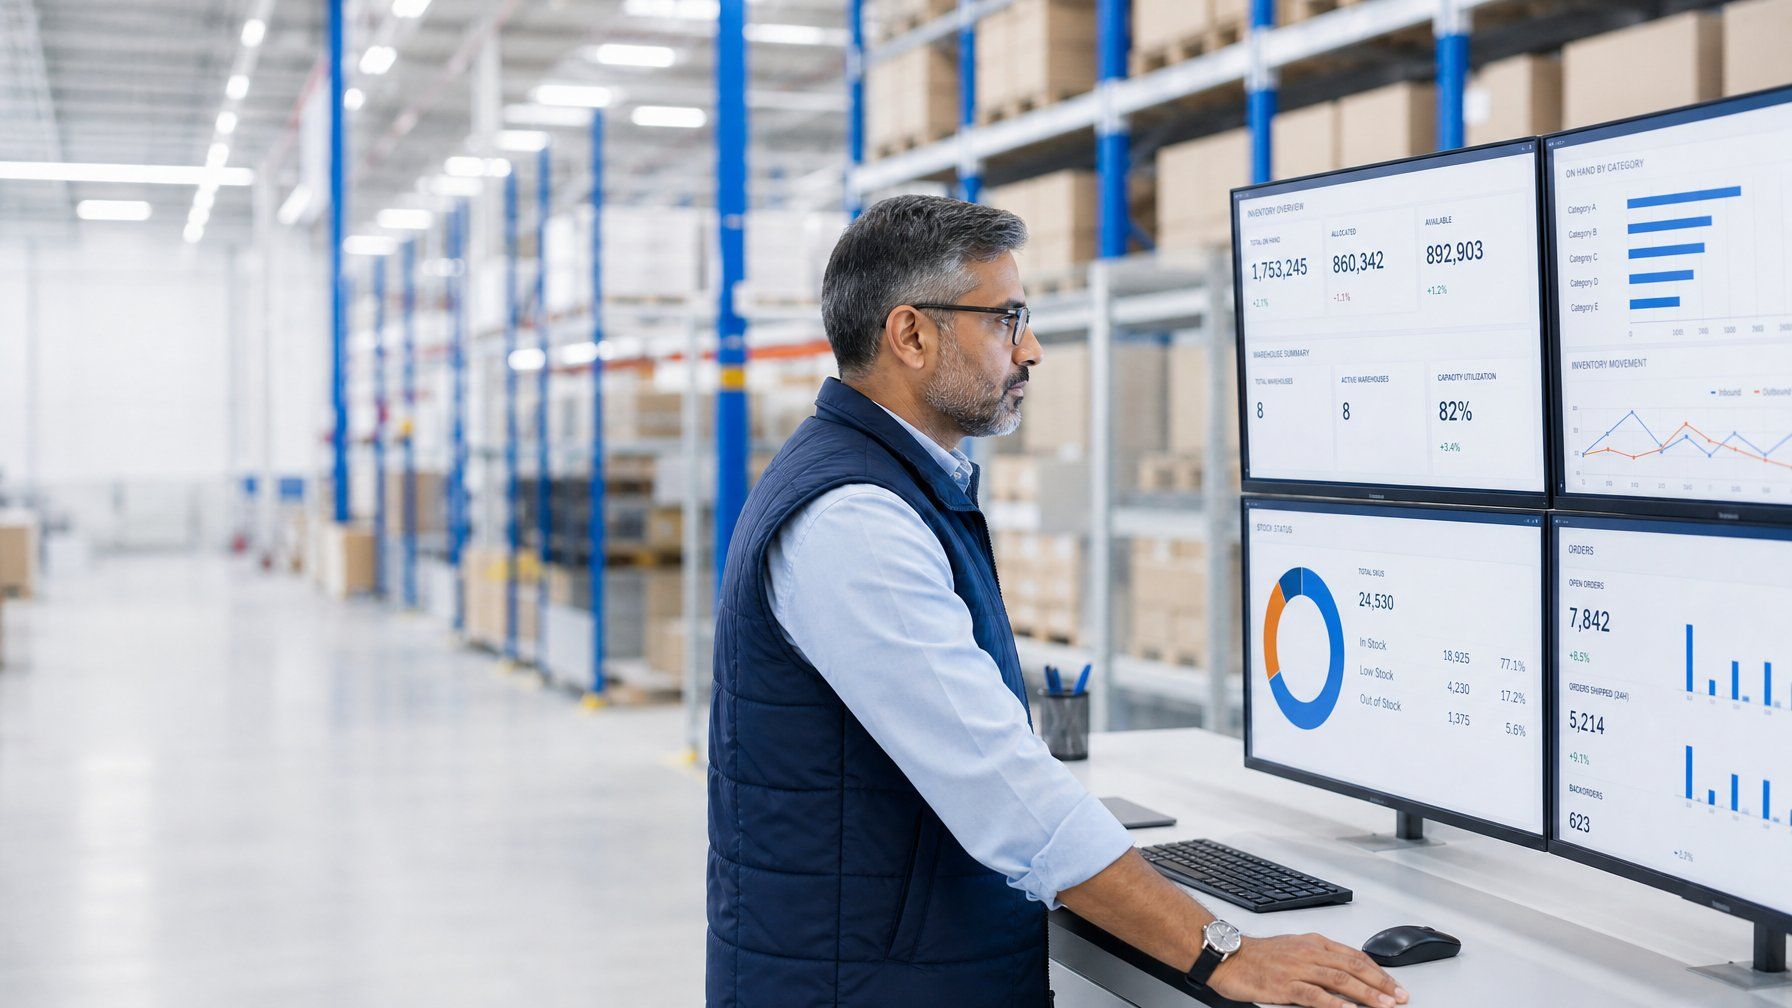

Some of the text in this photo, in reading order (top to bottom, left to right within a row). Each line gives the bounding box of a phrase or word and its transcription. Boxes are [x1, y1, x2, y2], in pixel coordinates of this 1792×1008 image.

[1566, 159, 1644, 178] ON HAND BY CATEGORY
[1248, 202, 1304, 218] INVENTORY OVERVIEW
[1568, 205, 1591, 214] Category
[1425, 216, 1452, 226] AVAILABLE
[1331, 228, 1356, 238] ALLOCATED
[1568, 228, 1597, 239] Category B
[1426, 240, 1483, 265] 892,903
[1593, 253, 1598, 261] C
[1333, 251, 1384, 274] 860,342
[1252, 258, 1308, 282] 1,753,245
[1427, 285, 1447, 295] +1.2%
[1570, 278, 1598, 288] Category D
[1571, 303, 1594, 313] Category
[1254, 349, 1309, 358] WAREHOUSE SUMMARY
[1572, 359, 1647, 370] INVENTORY MOVEMENT
[1438, 373, 1496, 381] CAPACITY UTILIZATION
[1257, 402, 1264, 419] 8
[1343, 402, 1350, 420] 8
[1439, 401, 1472, 421] 82%
[1440, 443, 1460, 452] +3.4%
[1257, 523, 1292, 534] STOCK STATUS
[1568, 544, 1594, 555] ORDERS
[1359, 568, 1372, 576] TOTAL
[1569, 579, 1604, 590] OPEN ORDERS
[1359, 591, 1394, 612] 24,530
[1570, 607, 1610, 632] 7,842
[1360, 637, 1387, 650] In Stock
[1443, 650, 1470, 664] 18,925
[1569, 651, 1590, 663] +8.5%
[1500, 658, 1526, 672] 77.1%
[1360, 665, 1394, 681] Low Stock
[1447, 681, 1470, 694] 4,230
[1569, 682, 1630, 702] ORDERS SHIPPED (24H)
[1360, 693, 1402, 712] Out of Stock
[1501, 690, 1526, 705] 17.2%
[1448, 711, 1470, 726] 1,375
[1569, 710, 1605, 735] 5,214
[1506, 722, 1526, 737] 5.6%
[1569, 752, 1589, 765] +9.1%
[1569, 783, 1603, 800] BACKORDERS
[1569, 812, 1590, 833] 623
